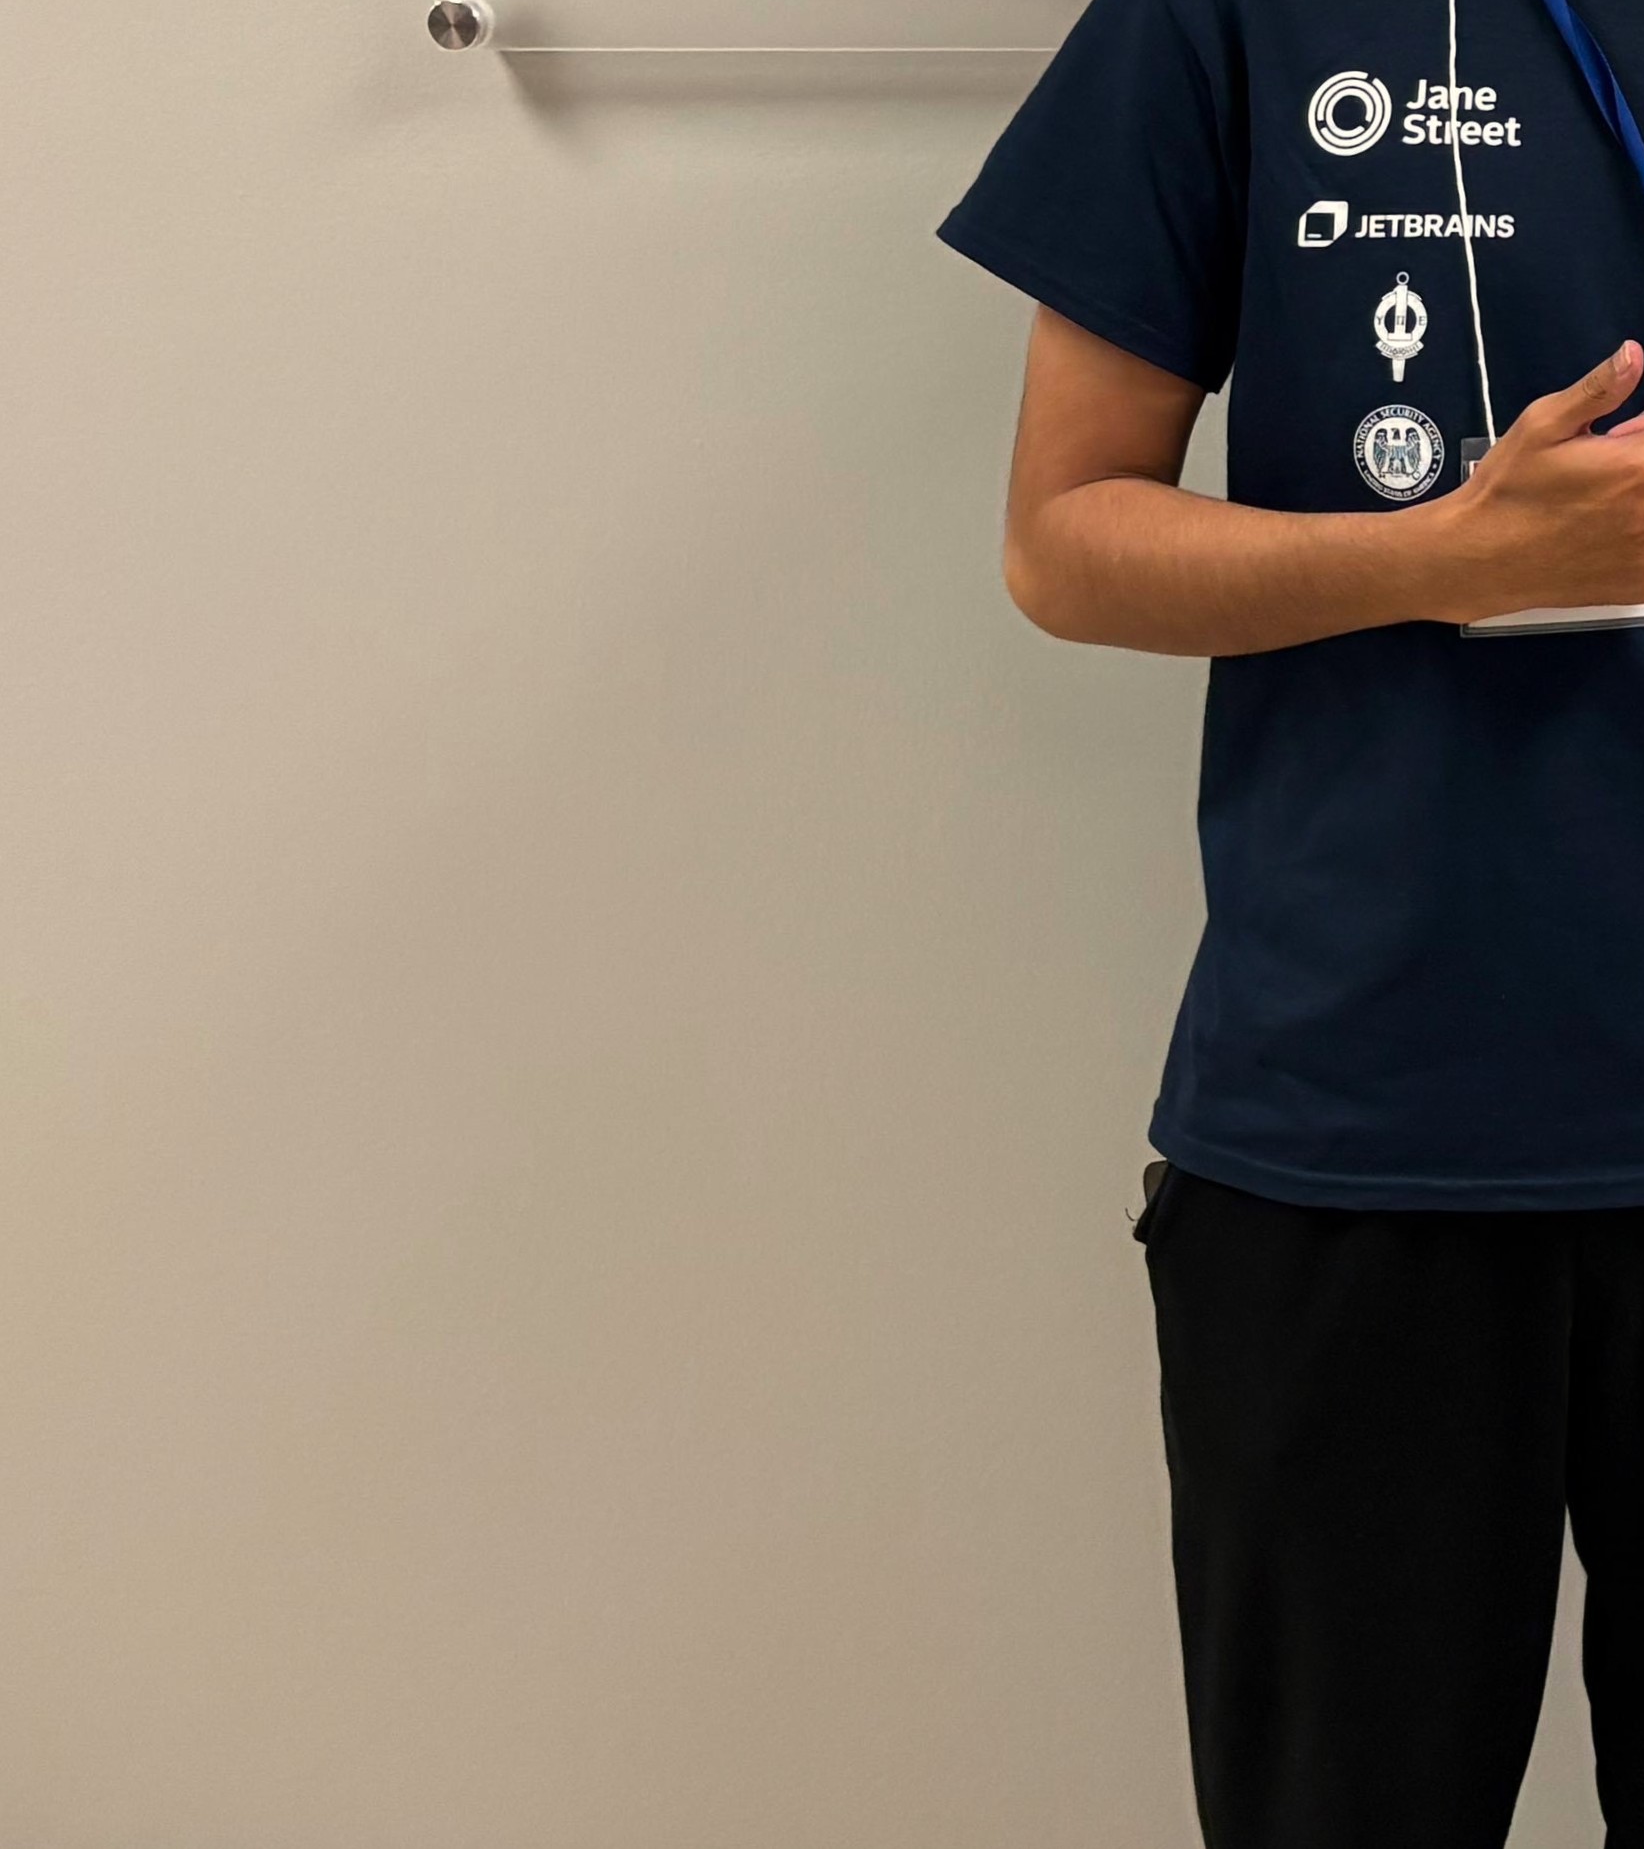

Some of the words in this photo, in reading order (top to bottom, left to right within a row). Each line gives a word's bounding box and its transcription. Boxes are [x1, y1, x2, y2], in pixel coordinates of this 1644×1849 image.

[1406, 79, 1497, 111] Jane
[1402, 113, 1522, 147] Street
[1355, 214, 1515, 238] JETBRAINS
[1356, 414, 1380, 458] NATIONAL
[1380, 406, 1424, 423] SECURITY
[1423, 422, 1442, 459] AGENCY
